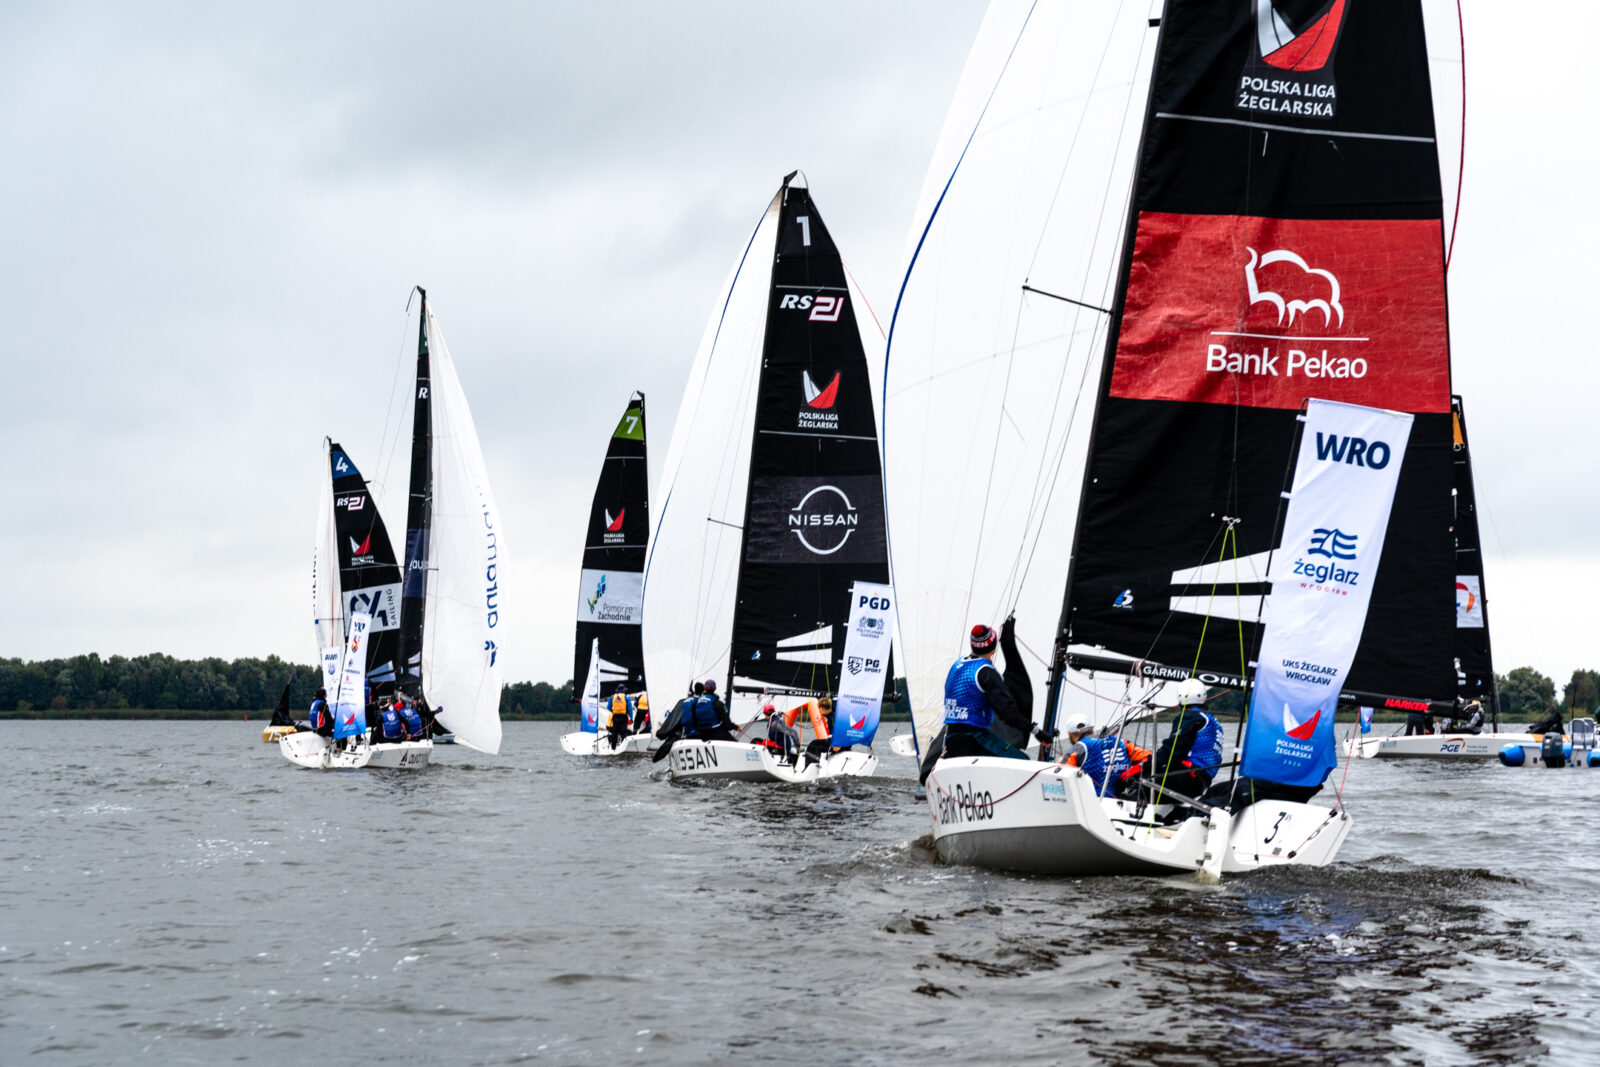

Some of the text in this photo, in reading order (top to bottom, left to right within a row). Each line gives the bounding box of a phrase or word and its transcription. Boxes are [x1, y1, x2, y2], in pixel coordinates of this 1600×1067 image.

[1241, 76, 1336, 98] POLSKA LIGA
[1238, 92, 1334, 117] ŻEGLARSKA
[796, 216, 811, 247] 1
[1206, 344, 1368, 378] Bank Pekao
[798, 412, 824, 421] POLSKA
[798, 419, 839, 430] ŻEGLARSKA
[626, 416, 638, 434] 7
[1316, 432, 1391, 470] WRO
[335, 457, 348, 473] 4
[788, 514, 858, 526] NISSAN
[1293, 558, 1360, 585] żeglarz
[386, 588, 398, 626] SAILING
[603, 603, 634, 613] Pomorze
[859, 595, 891, 611] PGD
[597, 612, 631, 622] Zachodnie
[865, 658, 880, 668] PG
[1282, 659, 1338, 677] UKS ŻEGLARZ
[1143, 666, 1190, 680] GARMIN
[1285, 670, 1331, 686] WROCŁAW
[1384, 697, 1430, 712] HARKEN
[1275, 746, 1312, 759] ŻEGLARSKA
[1276, 739, 1314, 752] POLSKA LIGA
[1440, 744, 1461, 752] PGE
[956, 781, 994, 823] Pekao
